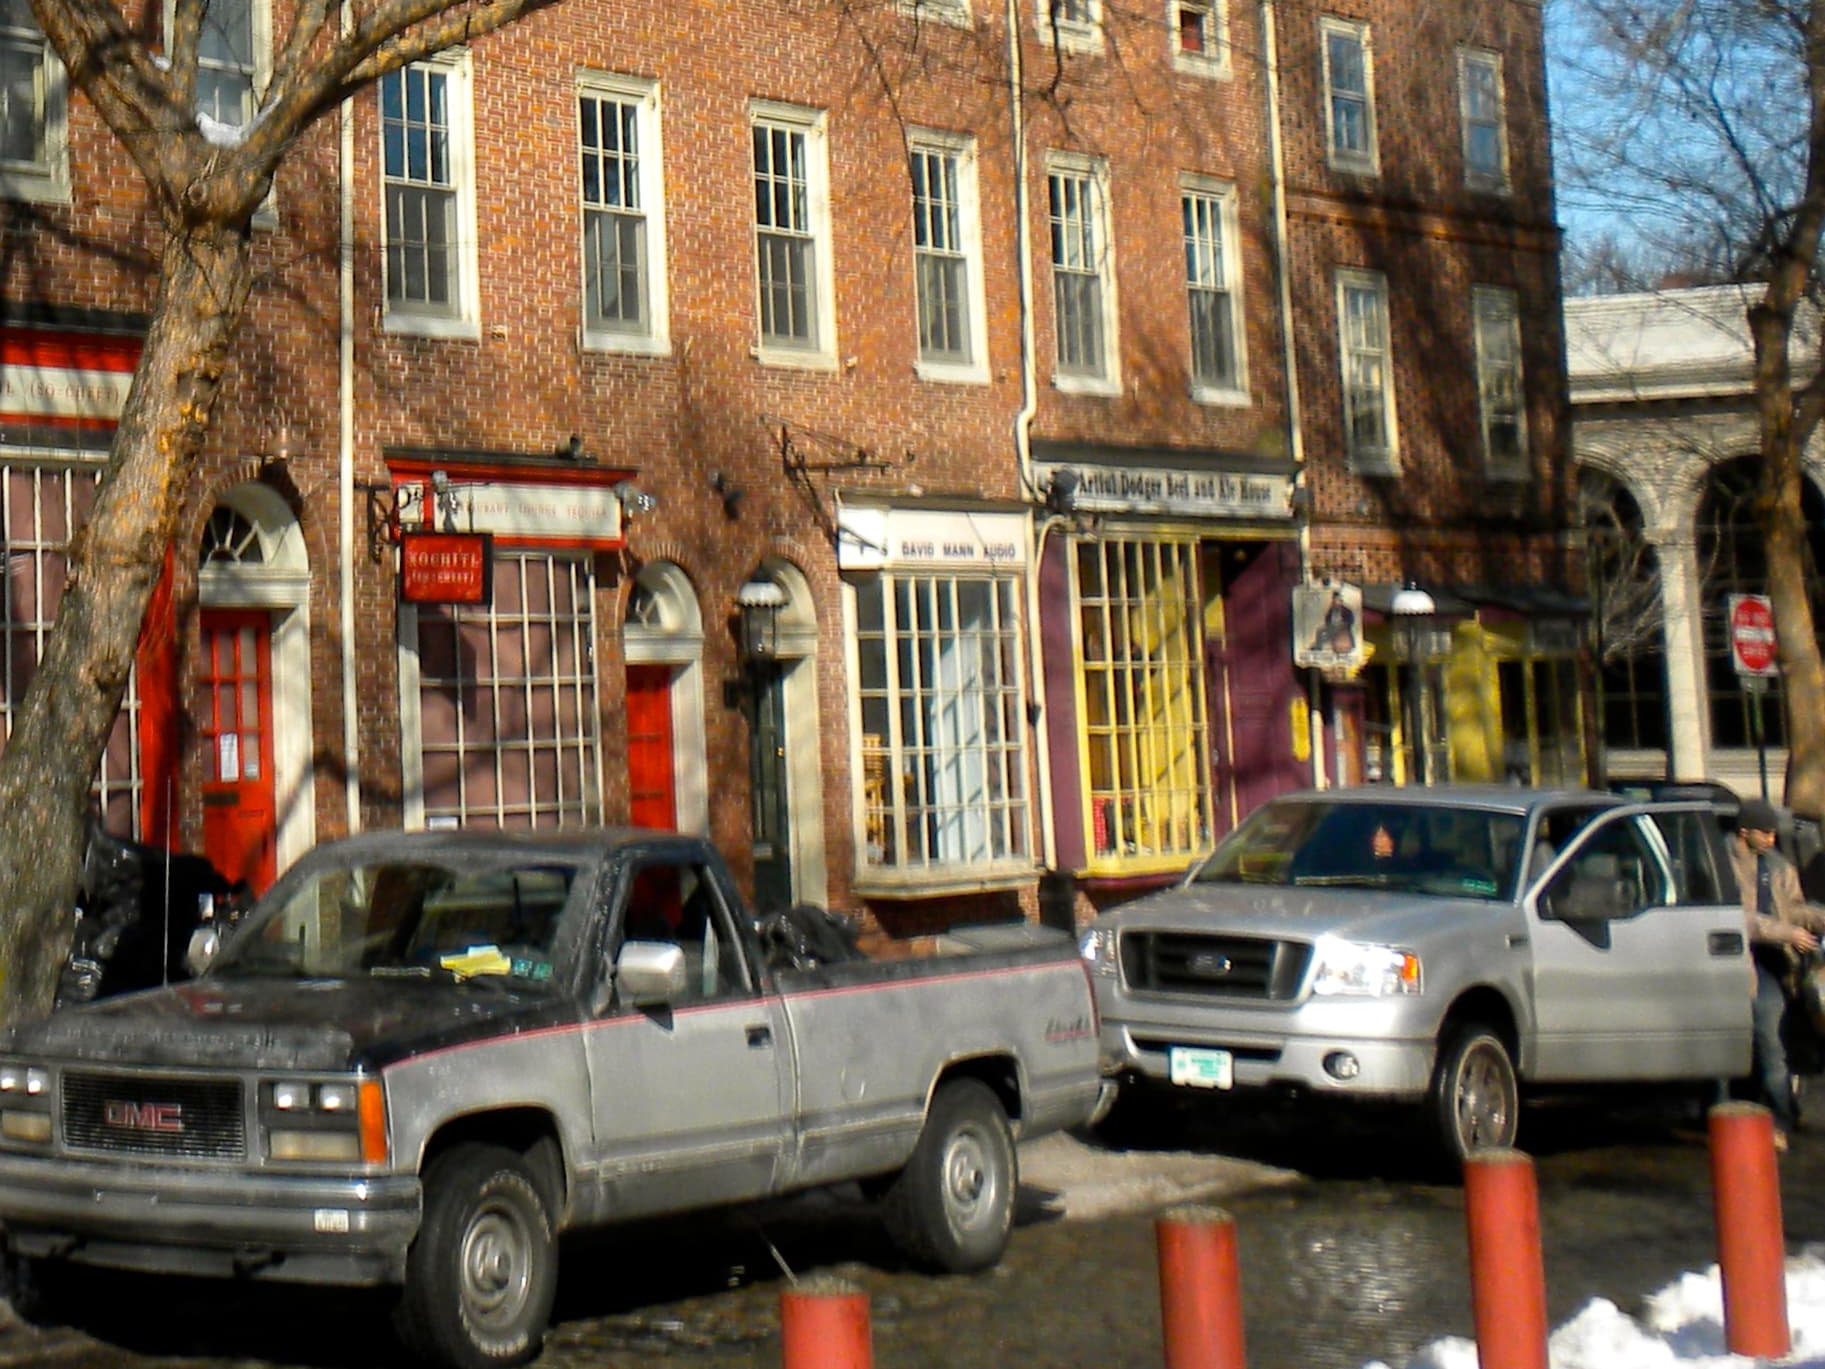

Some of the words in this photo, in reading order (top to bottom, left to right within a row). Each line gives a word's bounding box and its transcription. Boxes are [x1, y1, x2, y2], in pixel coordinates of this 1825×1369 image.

[1079, 471, 1117, 494] Artful
[1120, 472, 1162, 501] Dodger
[902, 541, 935, 557] DAVID
[943, 542, 975, 557] MANN
[983, 543, 1016, 558] AUDIO
[103, 1100, 184, 1132] GMC
